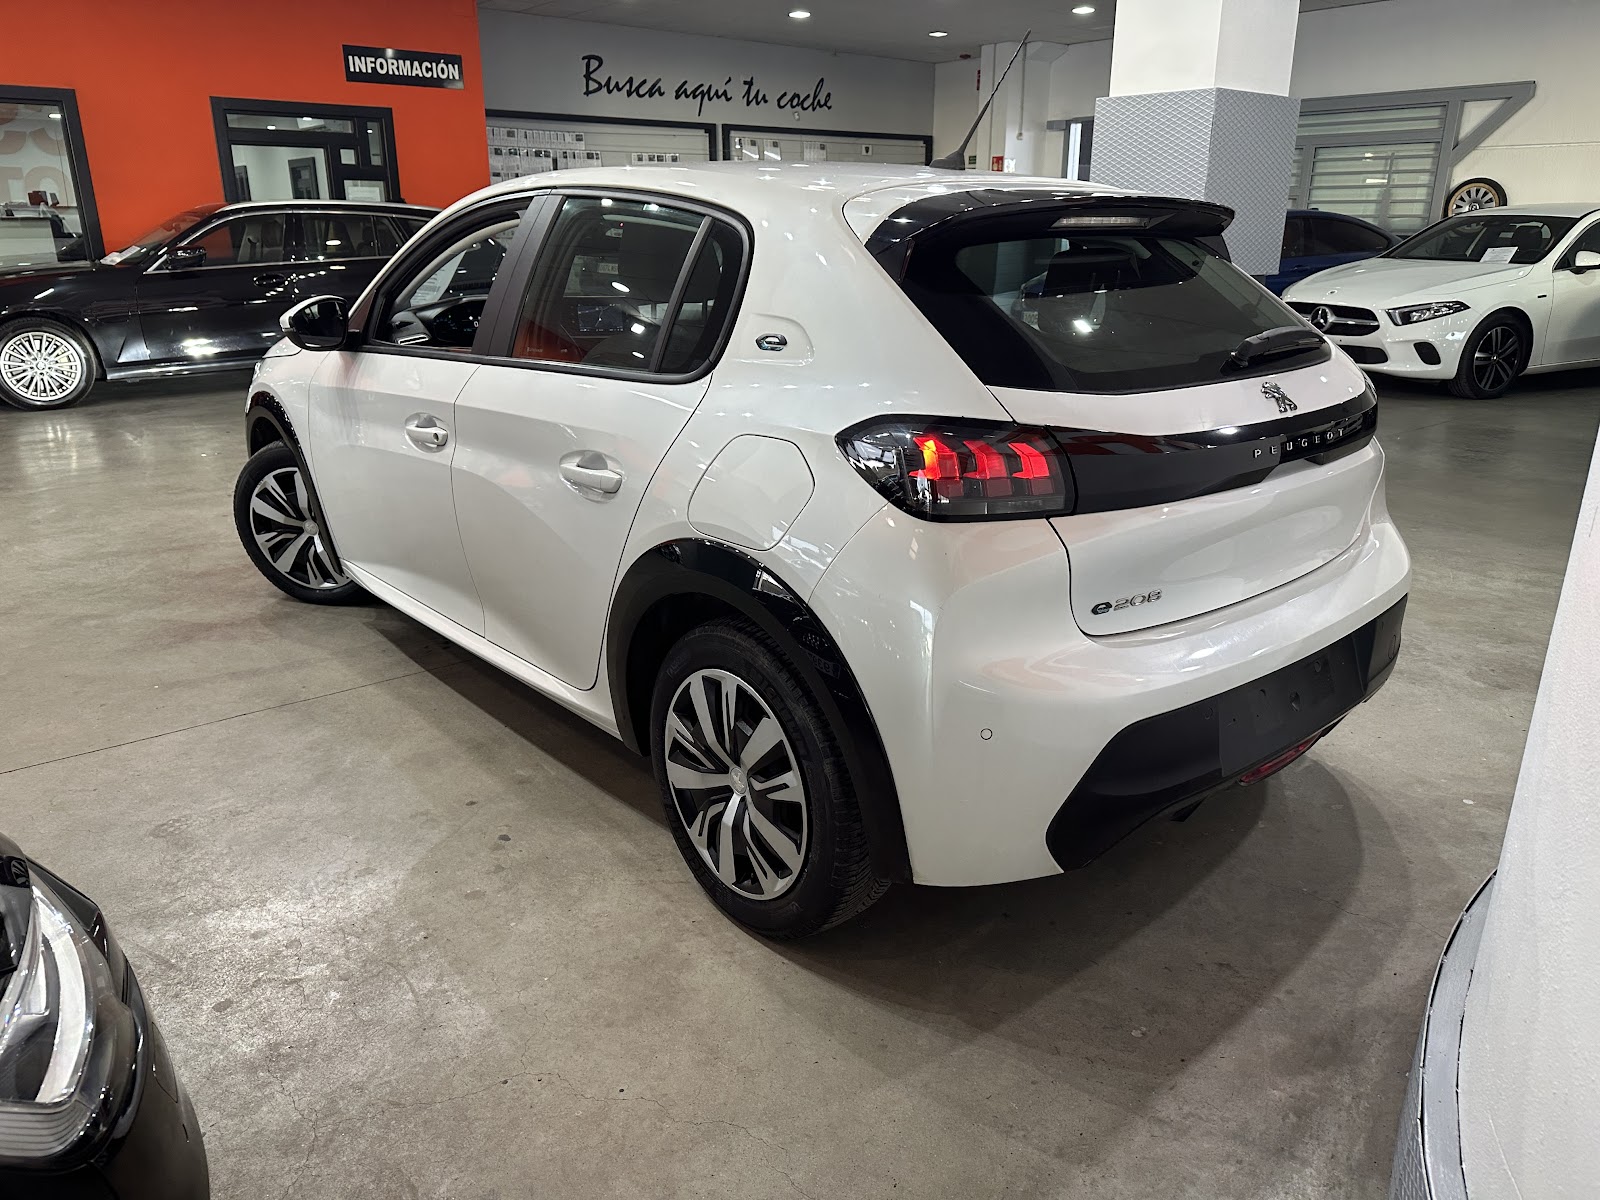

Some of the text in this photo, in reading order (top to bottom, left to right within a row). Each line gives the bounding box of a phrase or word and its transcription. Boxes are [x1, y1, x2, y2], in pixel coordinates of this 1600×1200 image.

[348, 55, 460, 80] INFORMACIÓN
[581, 54, 833, 116] Busca aquí tu coche
[1253, 427, 1344, 458] PEUGEOT
